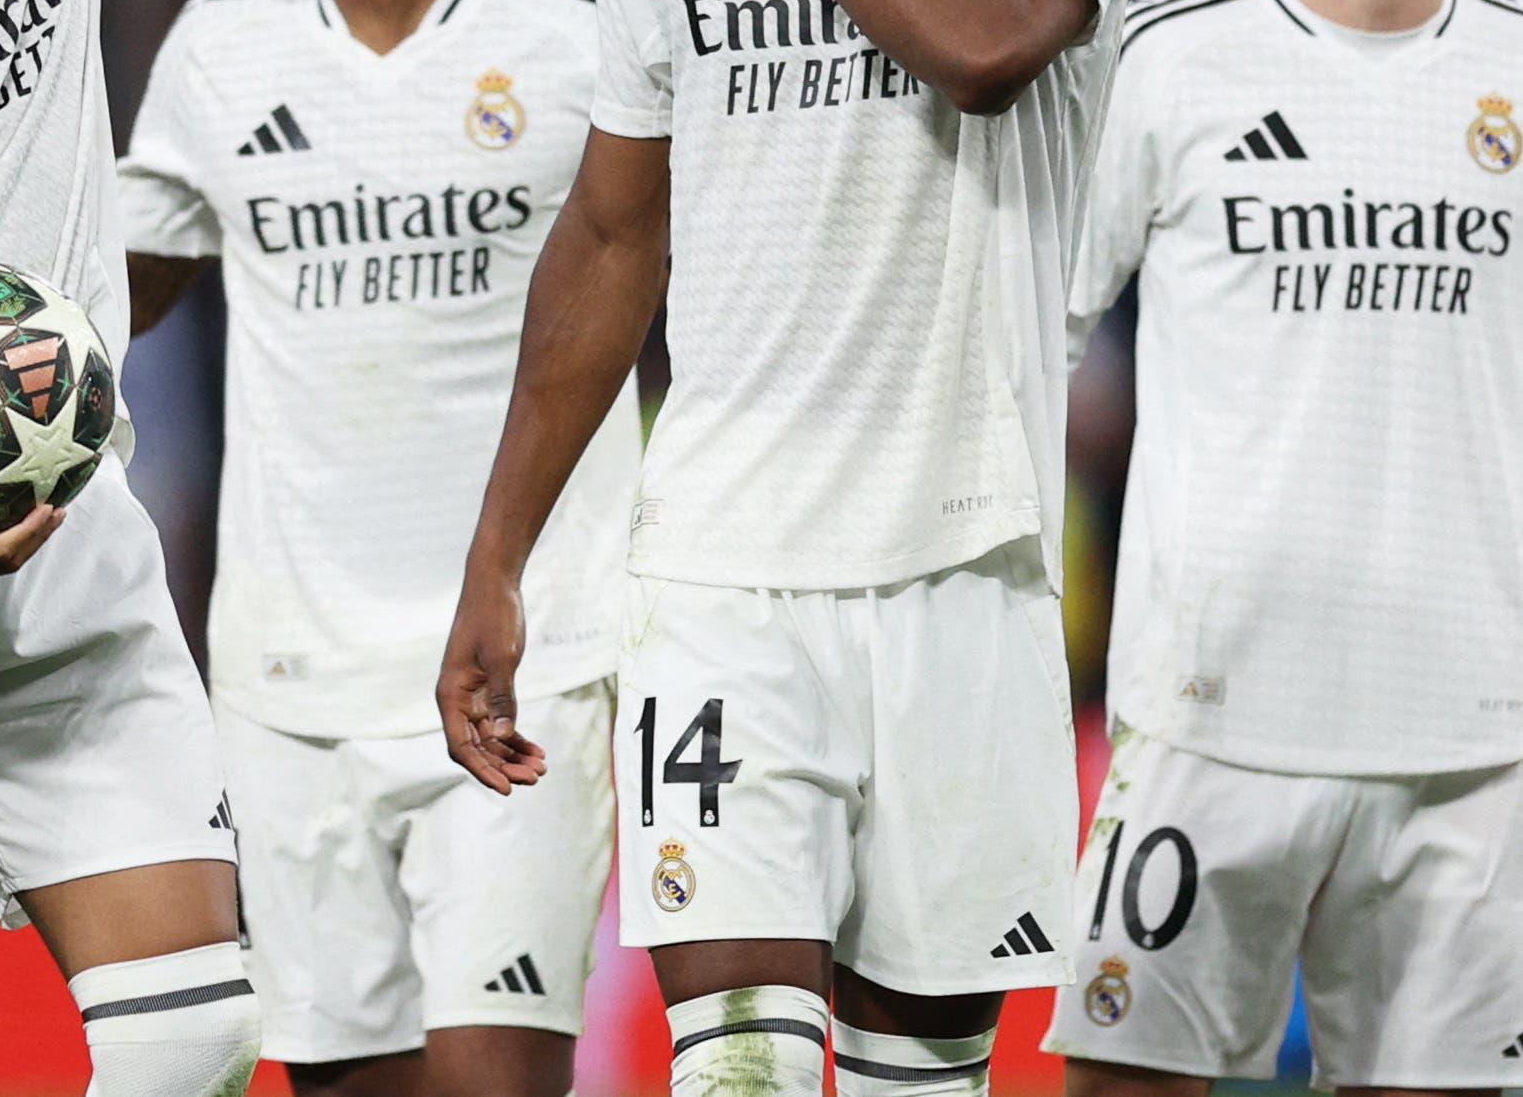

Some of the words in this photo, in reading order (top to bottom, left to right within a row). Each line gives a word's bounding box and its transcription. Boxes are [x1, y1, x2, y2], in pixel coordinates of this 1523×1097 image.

[727, 60, 786, 116] FLY
[247, 183, 533, 254] Emirates
[1223, 188, 1513, 257] Emirates
[296, 261, 346, 311] FLY
[363, 245, 491, 304] BETTER
[1272, 264, 1331, 313] FLY
[1345, 262, 1473, 314] BETTER
[634, 696, 743, 827] 14
[1087, 820, 1199, 951] 10
